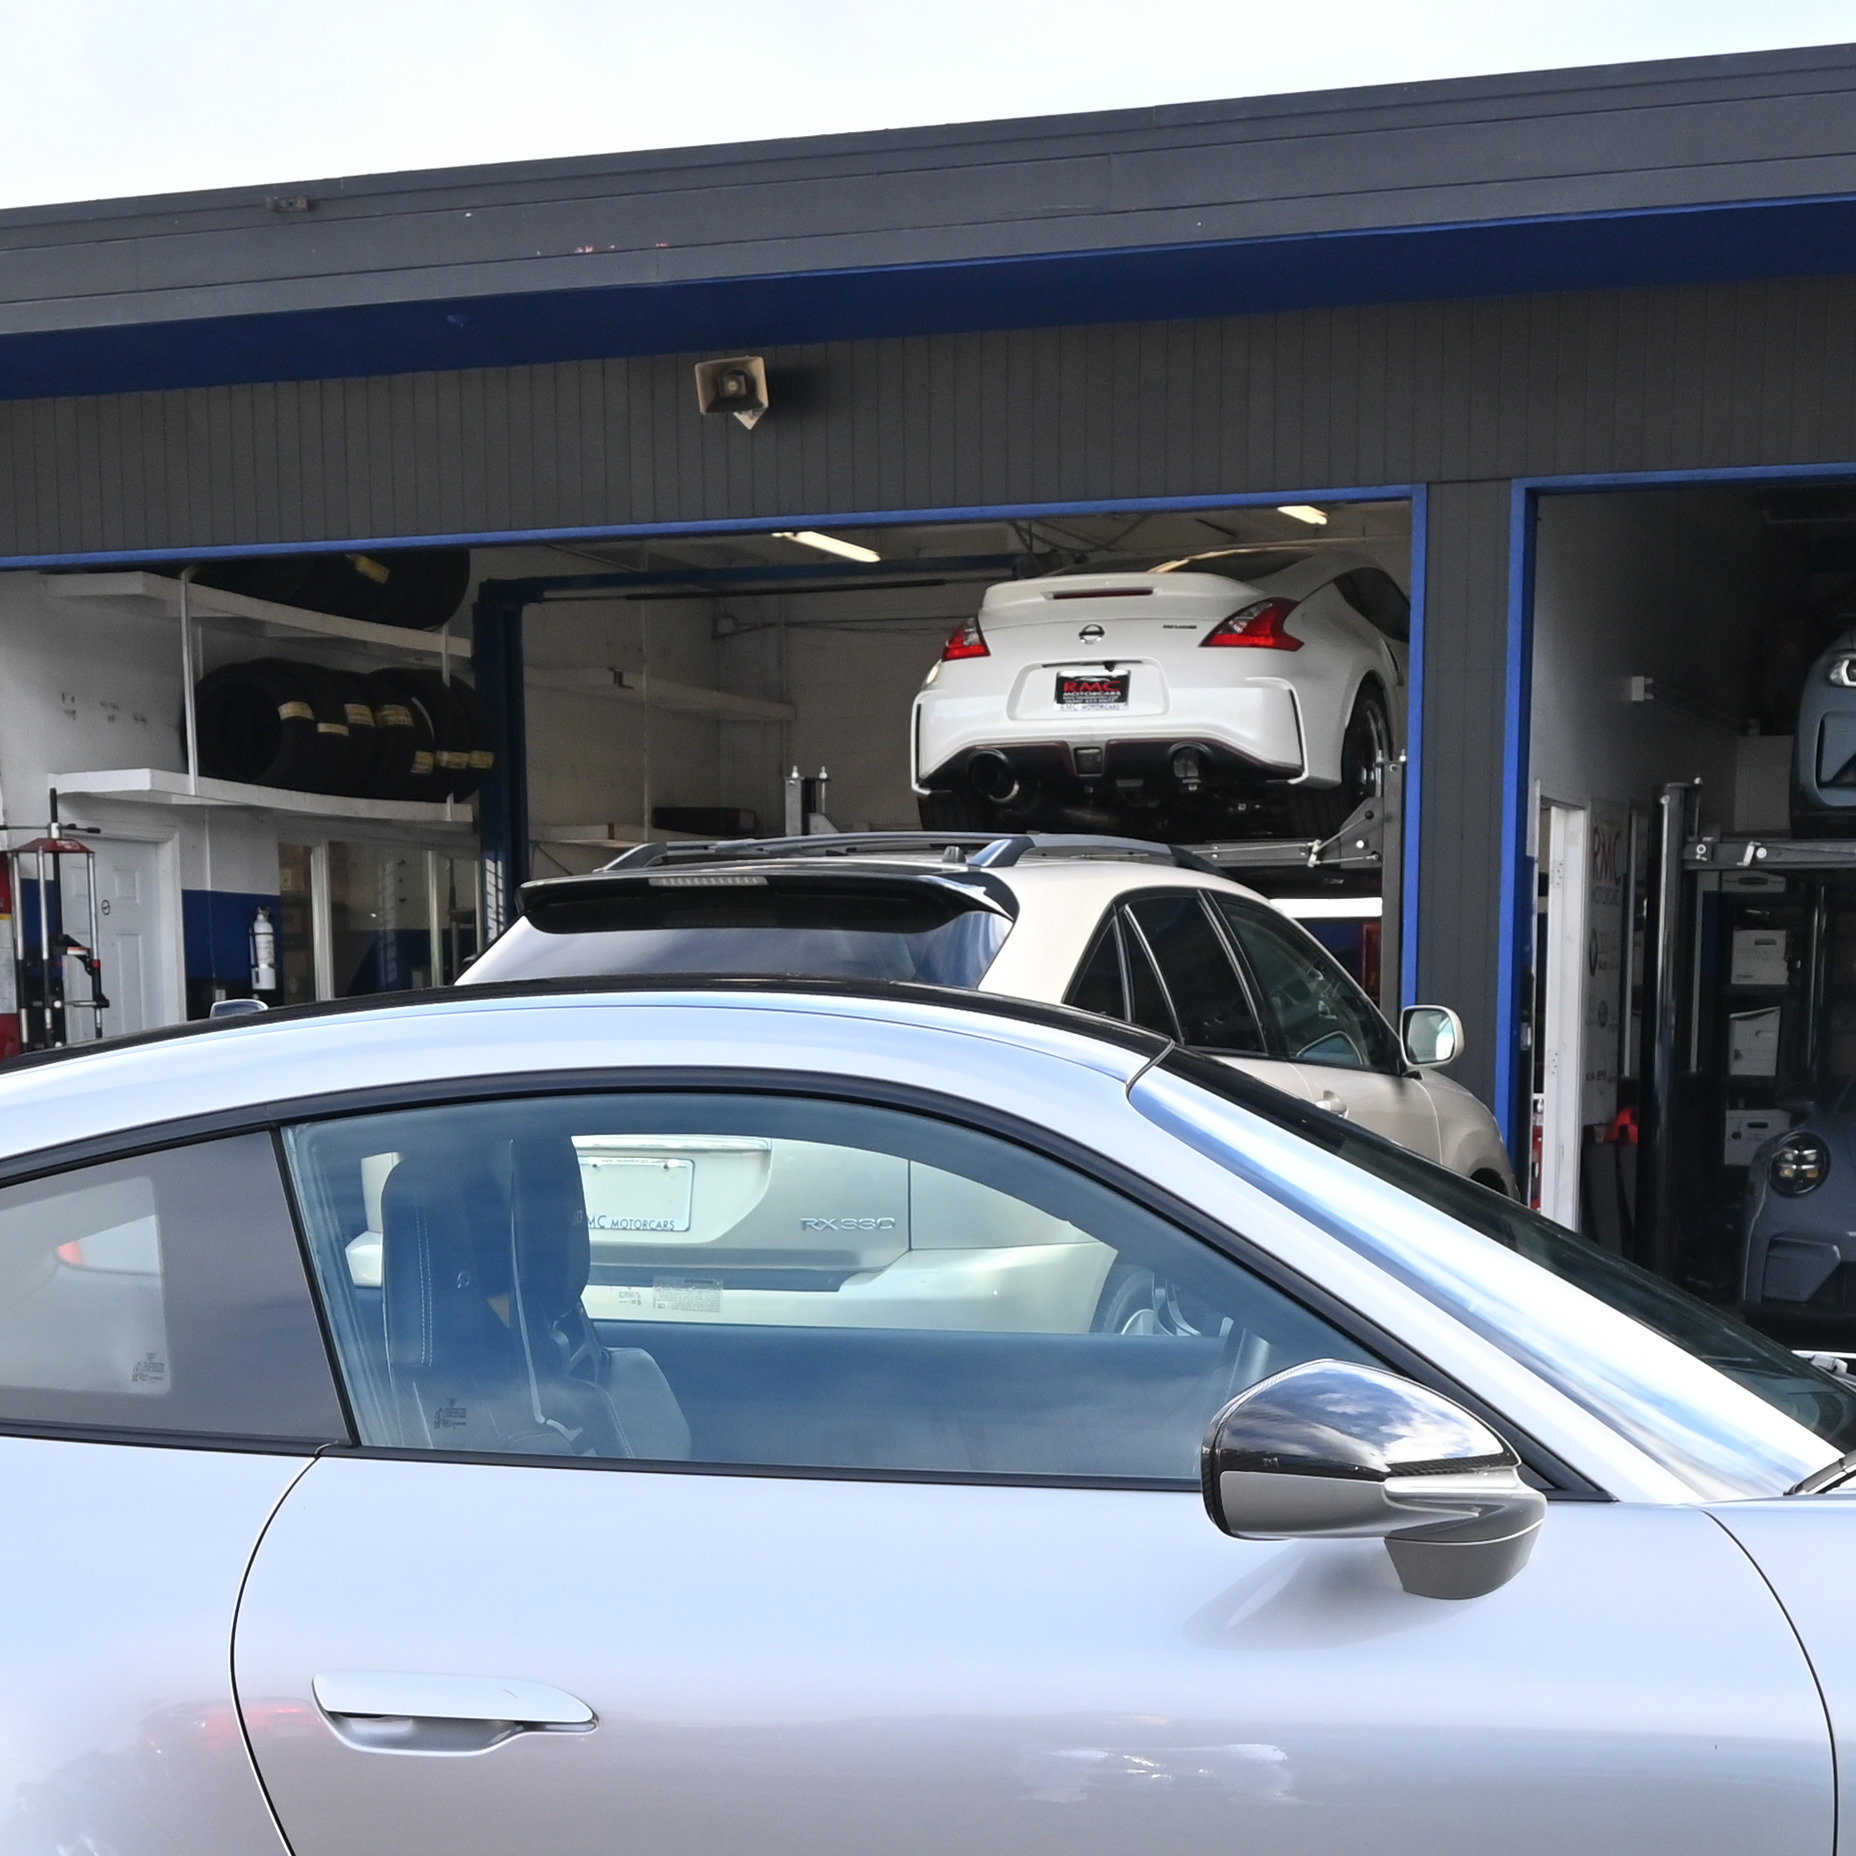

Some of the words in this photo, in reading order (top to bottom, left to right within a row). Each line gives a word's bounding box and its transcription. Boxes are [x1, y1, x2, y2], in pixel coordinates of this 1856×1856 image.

[1064, 681, 1120, 692] RMC
[587, 1215, 607, 1230] MC
[610, 1218, 676, 1231] MOTORCARS
